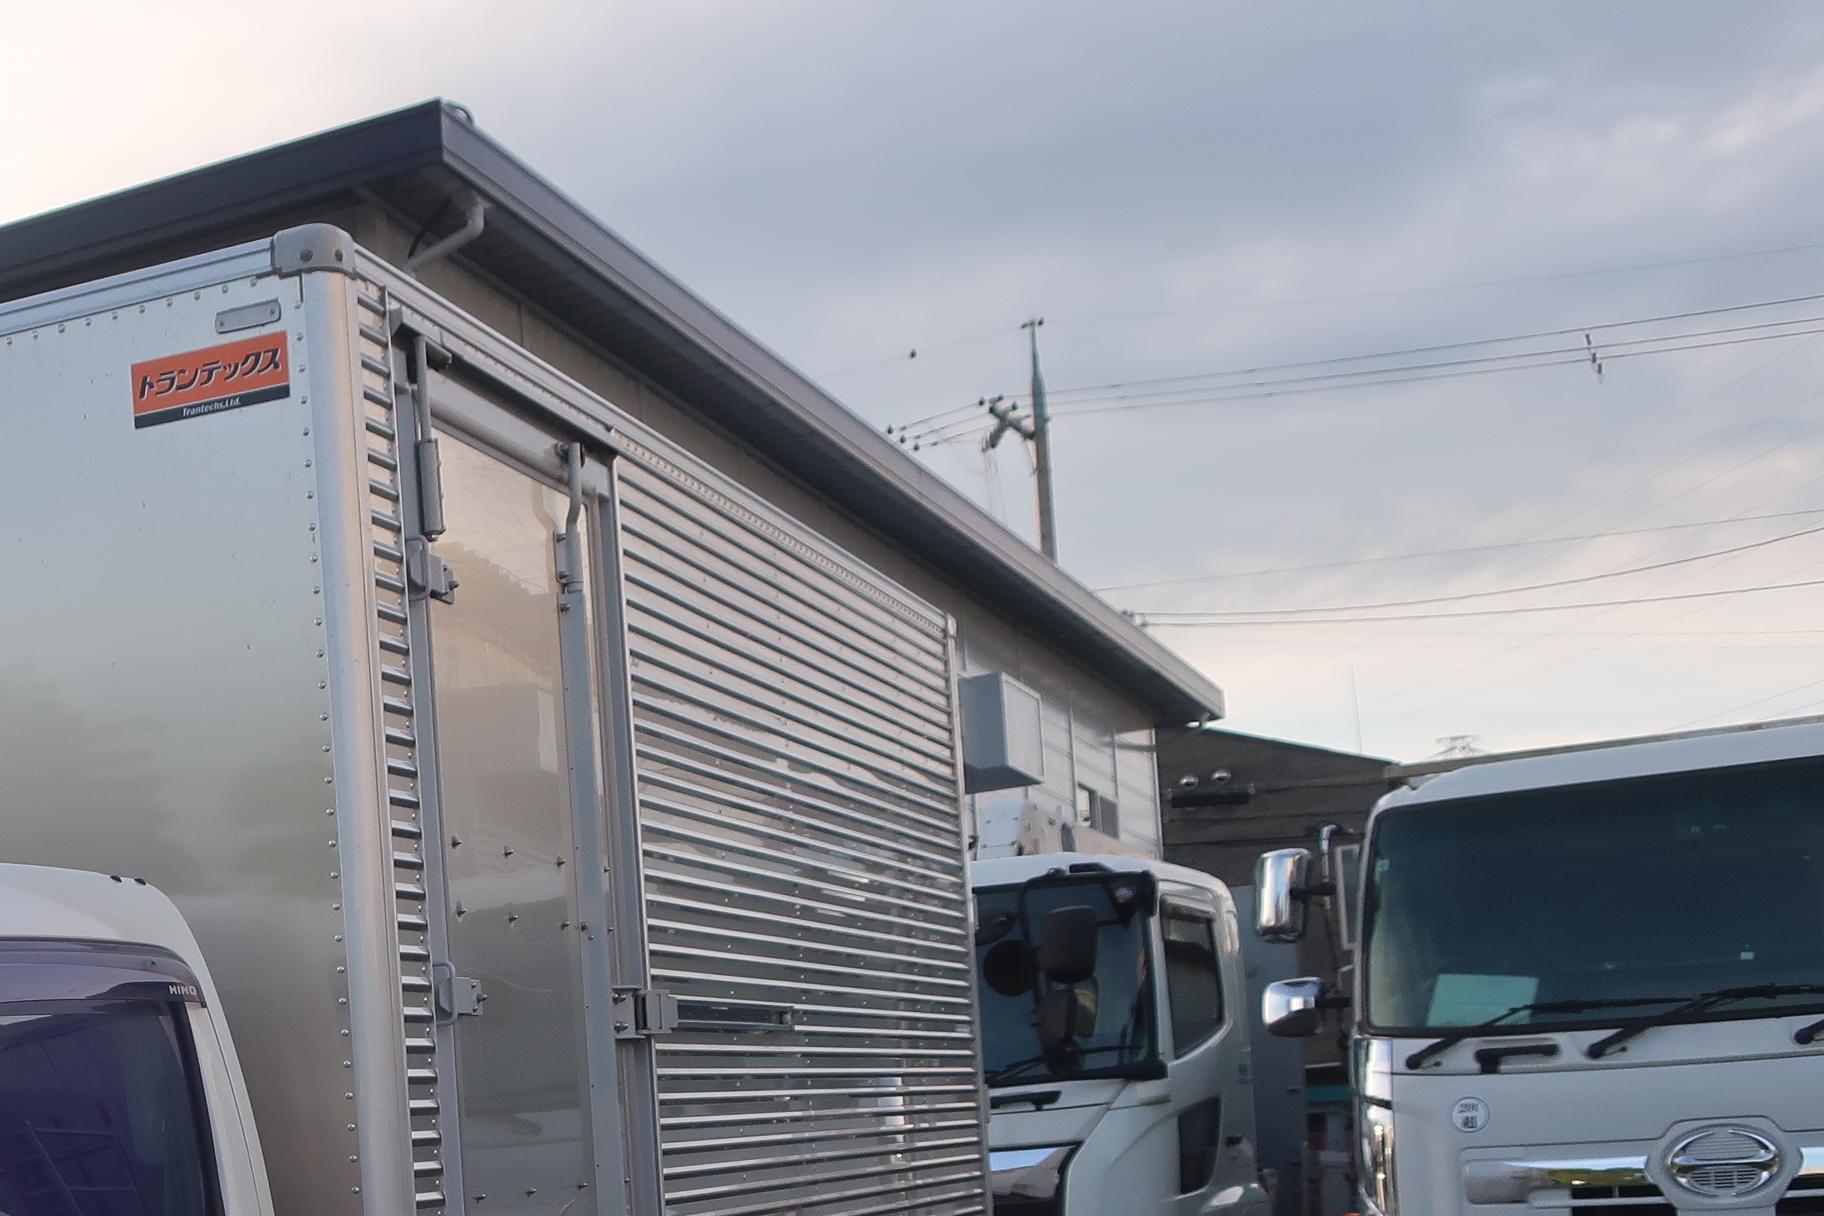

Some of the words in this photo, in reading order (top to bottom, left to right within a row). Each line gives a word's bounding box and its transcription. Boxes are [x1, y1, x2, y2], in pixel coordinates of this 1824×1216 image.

[139, 347, 281, 400] トランテックス
[168, 985, 197, 996] HINO
